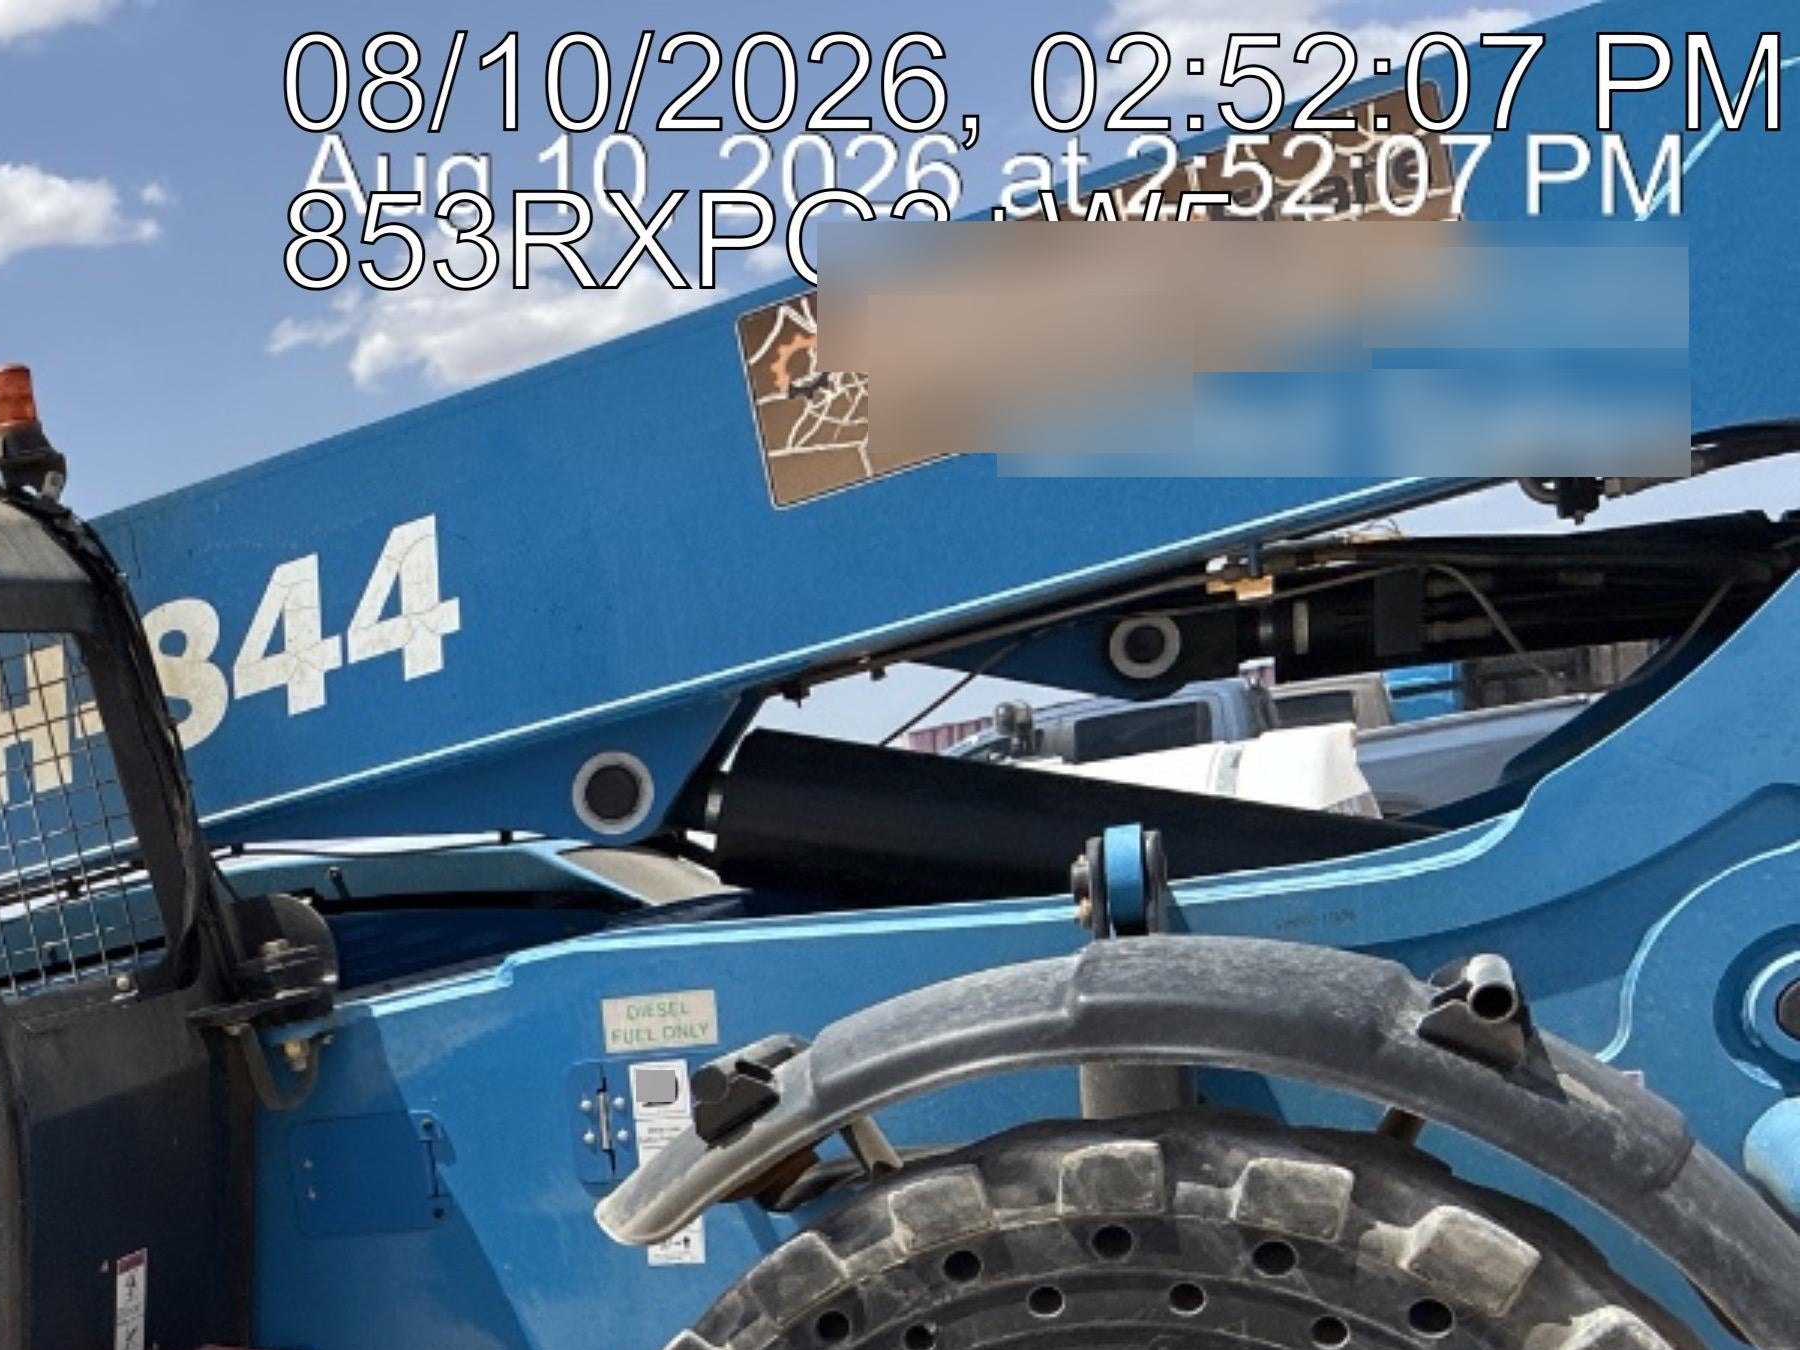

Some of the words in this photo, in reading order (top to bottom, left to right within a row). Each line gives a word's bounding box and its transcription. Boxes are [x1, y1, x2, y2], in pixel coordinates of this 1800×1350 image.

[626, 1001, 689, 1021] DIESEL
[610, 1028, 657, 1045] FUEL
[663, 1022, 709, 1040] ONLY
